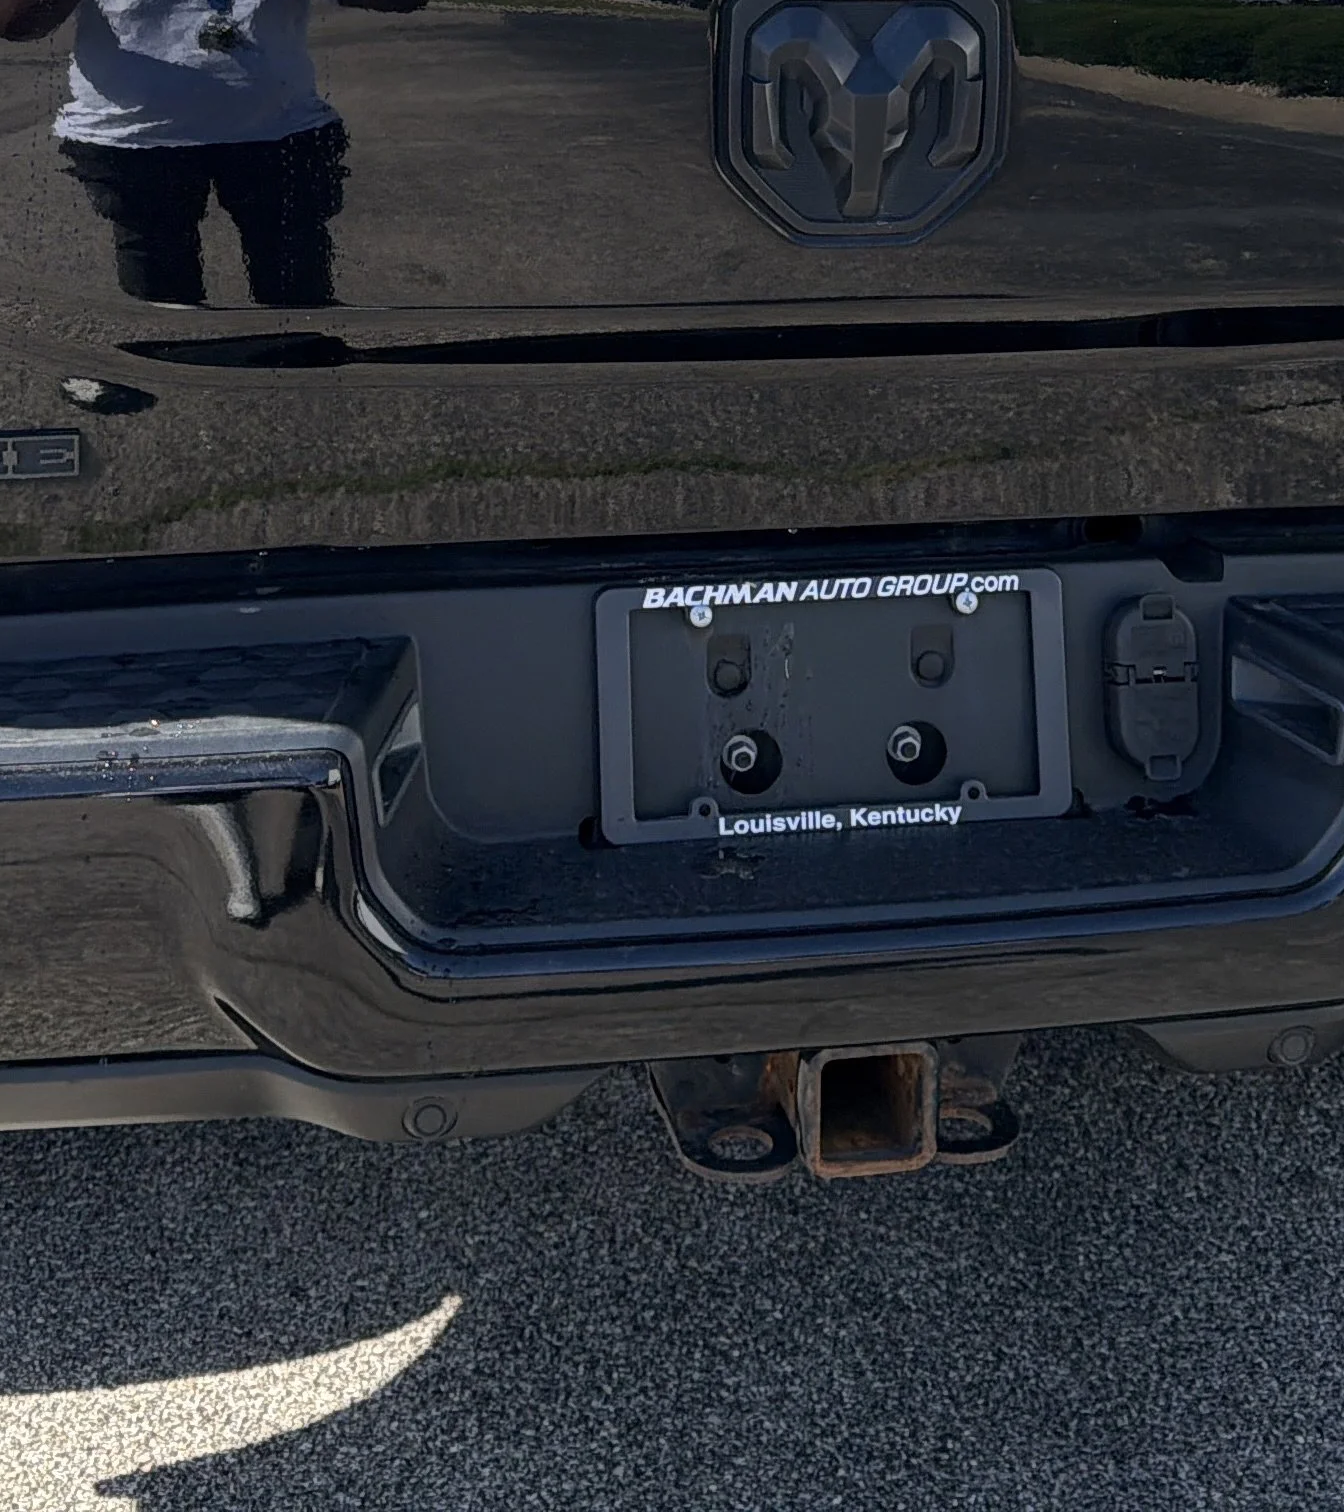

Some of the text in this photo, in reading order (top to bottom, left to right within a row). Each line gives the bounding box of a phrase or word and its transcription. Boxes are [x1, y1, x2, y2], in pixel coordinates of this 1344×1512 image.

[642, 582, 798, 609] BACHMAN
[799, 578, 872, 601] AUTO
[718, 803, 962, 836] Louisville, Kentucky
